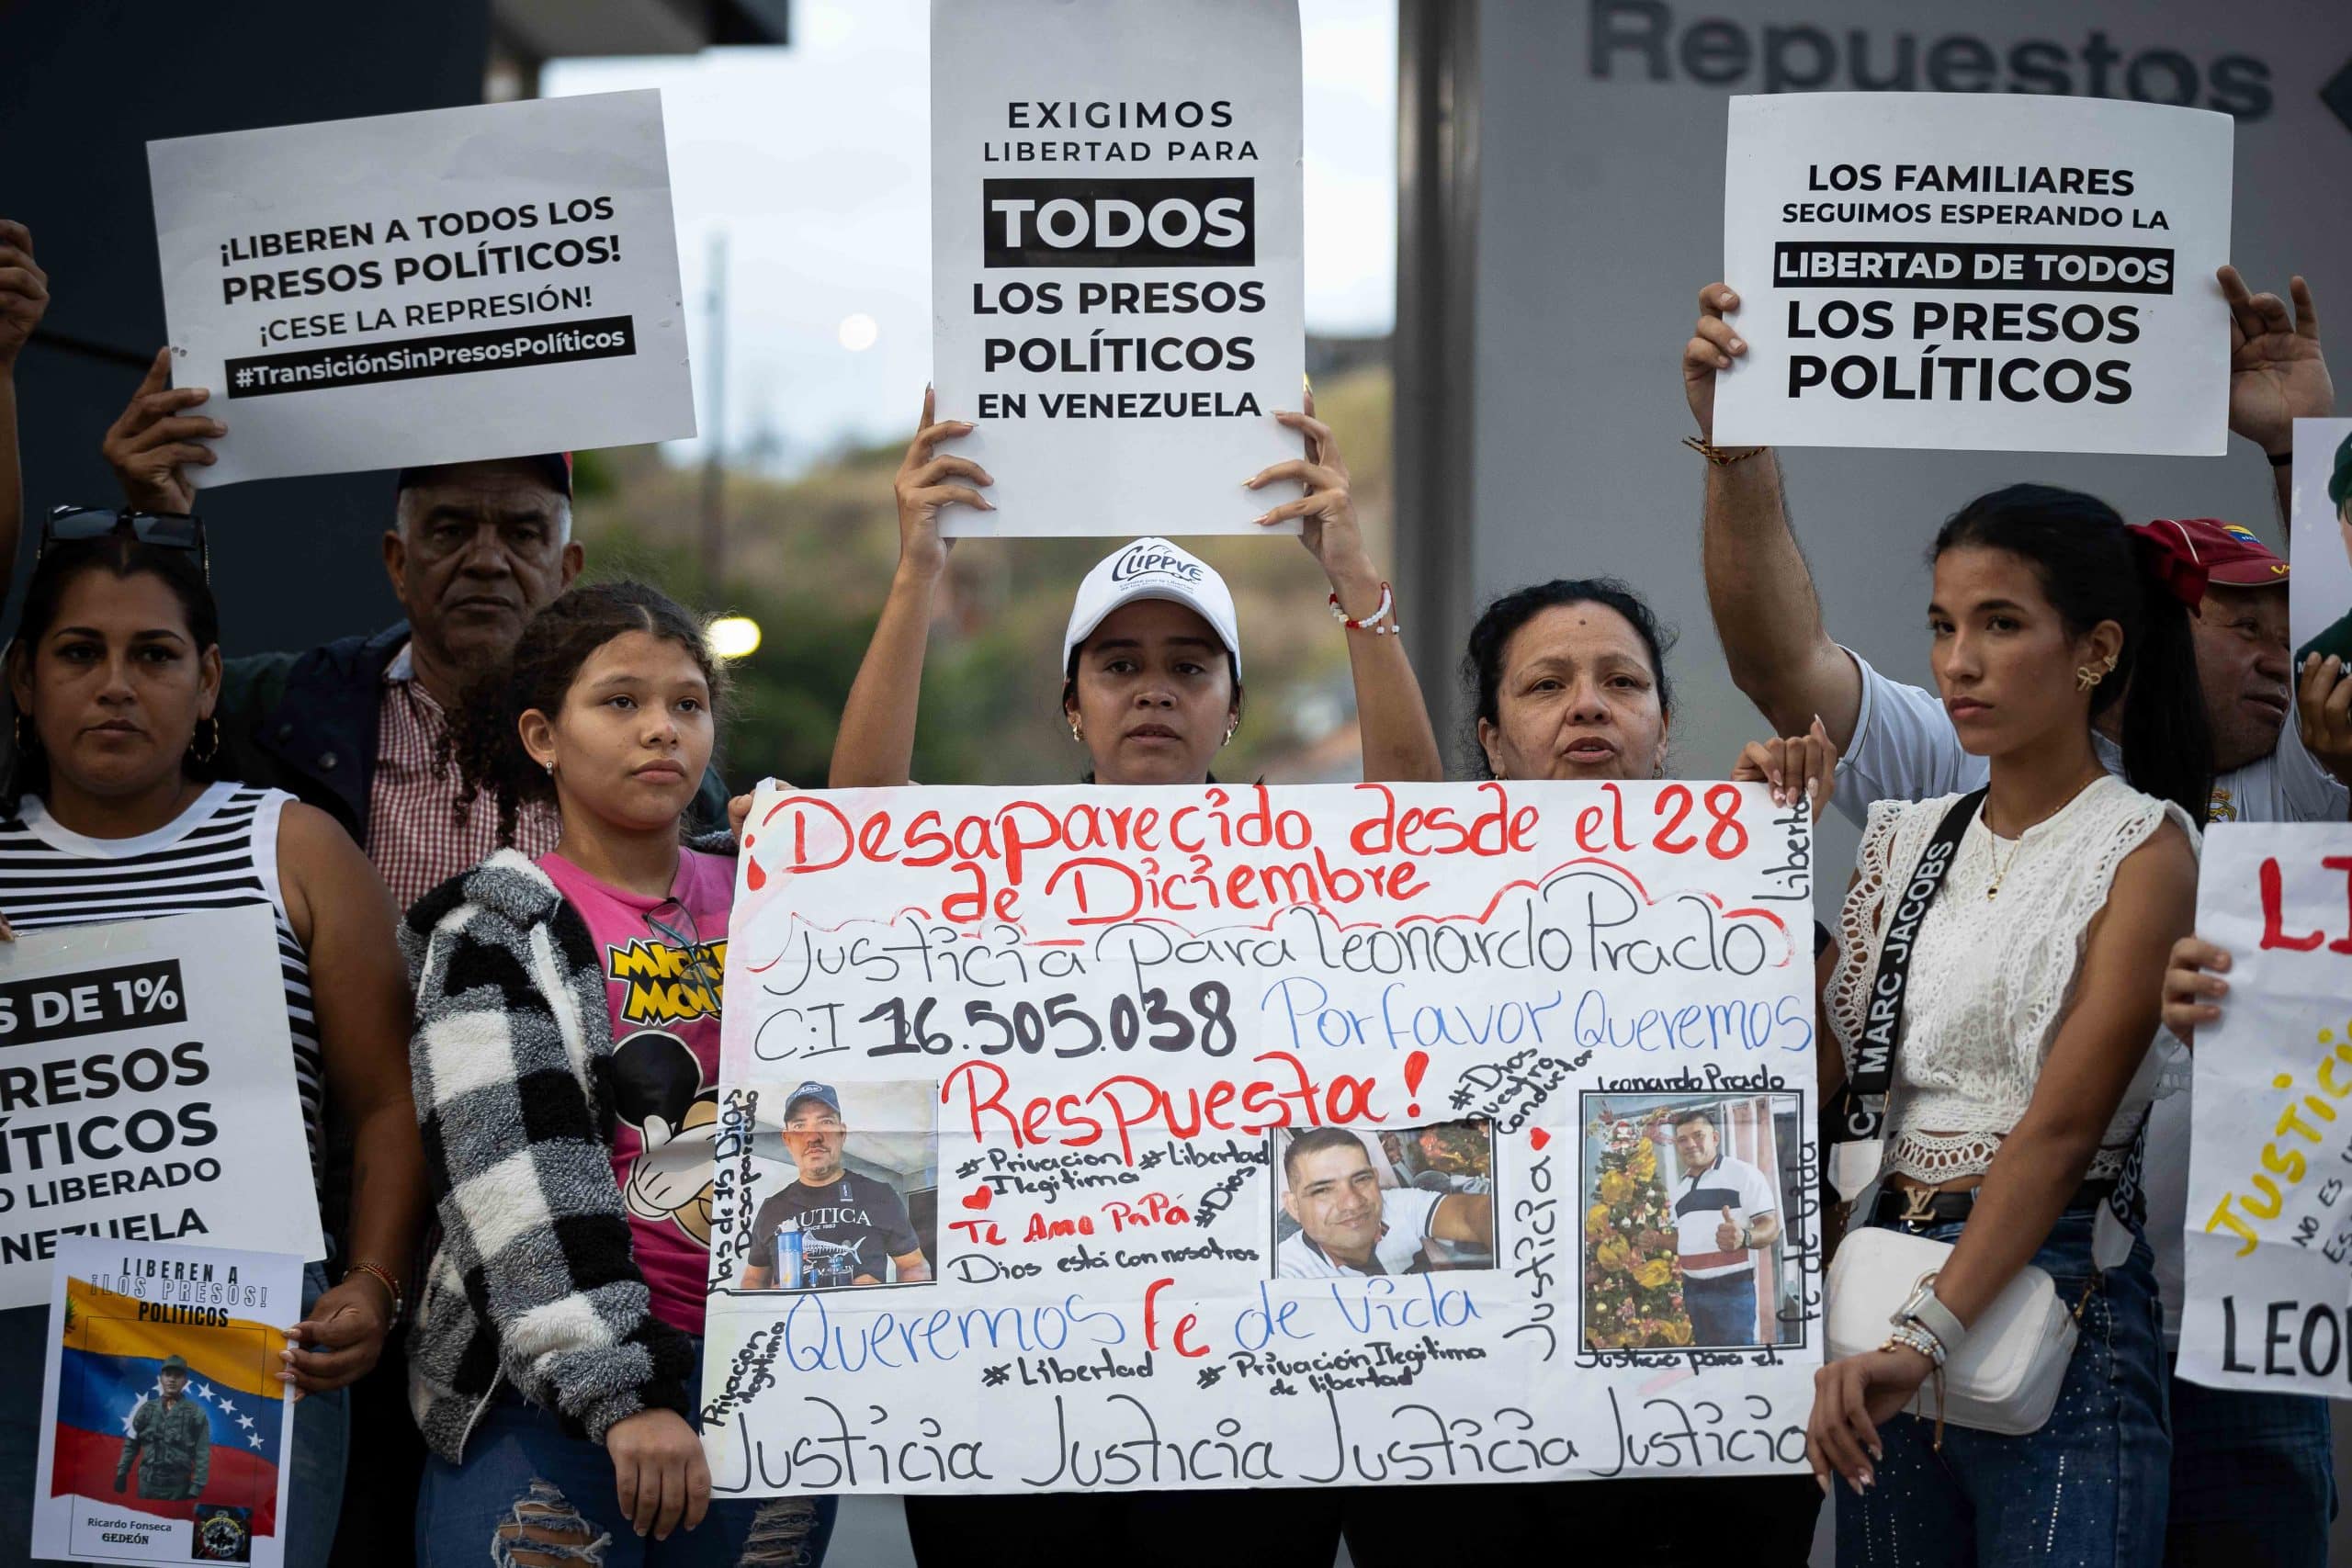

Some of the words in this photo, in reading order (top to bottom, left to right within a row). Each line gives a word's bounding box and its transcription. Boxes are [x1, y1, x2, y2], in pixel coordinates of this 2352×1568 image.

[1589, 0, 2274, 119] Repuestos
[1009, 100, 1233, 129] EXIGIMOS
[984, 141, 1151, 162] LIBERTAD
[1168, 141, 1259, 161] PARA
[1808, 164, 1882, 192] LOS
[1894, 164, 2134, 197] FAMILIARES
[220, 221, 374, 267] ¡LIBEREN
[385, 220, 410, 243] A
[417, 204, 538, 240] TODOS
[548, 197, 615, 225] LOS
[991, 197, 1246, 248] TODOS
[1781, 202, 1931, 224] SEGUIMOS
[1940, 204, 2122, 228] ESPERANDO
[2132, 209, 2170, 231] LA
[221, 260, 383, 305] PRESOS
[395, 234, 622, 286] POLÍTICOS!
[1779, 251, 1962, 281] LIBERTAD
[1973, 254, 2024, 281] DE
[2035, 254, 2169, 286] TODOS
[259, 313, 345, 348] ¡CESE
[356, 309, 397, 332] LA
[404, 286, 593, 325] REPRESIÓN!
[973, 282, 1063, 315] LOS
[1079, 280, 1266, 314] PRESOS
[1787, 299, 1894, 339] LOS
[1913, 300, 2140, 344] PRESOS
[235, 328, 626, 389] #TransiciónSinPresosPolíticos
[984, 328, 1256, 373] POLÍTICOS
[1788, 344, 2132, 405] POLÍTICOS
[978, 393, 1026, 419] EN
[1038, 391, 1261, 419] VENEZUELA
[1350, 783, 1540, 856] desde
[1576, 783, 1643, 852] el
[1653, 784, 1749, 860] 28
[941, 862, 1024, 922] de
[1046, 847, 1430, 925] Diciembre
[763, 916, 1086, 995] Justicia
[1544, 872, 1766, 975] Prado
[1859, 973, 1903, 1073] MARC
[1884, 840, 1954, 964] JACOBS
[31, 985, 104, 1028] DE
[113, 974, 179, 1017] 1%
[858, 981, 1237, 1058] 16.505.038
[1261, 976, 1374, 1049] Por
[1574, 989, 1813, 1052] Queremos
[1703, 1063, 1785, 1091] Prado
[27, 1157, 221, 1209] LIBERADO
[711, 1208, 733, 1234] de
[948, 1219, 1007, 1246] Te
[2291, 1215, 2320, 1247] NO
[2318, 1177, 2344, 1208] ES
[122, 1258, 214, 1282] LIBEREN
[228, 1266, 238, 1284] A
[947, 1253, 1042, 1283] Dios
[1161, 1236, 1260, 1264] nosotros
[1502, 1156, 1557, 1361] Justicia
[139, 1301, 229, 1327] POLITICOS
[162, 1279, 267, 1308] PRESOS!
[785, 1292, 1126, 1371] Queremos
[1235, 1280, 1317, 1351] de
[2222, 1295, 2352, 1384] LEO
[980, 1348, 1154, 1388] #Libertad
[1270, 1378, 1298, 1396] de
[711, 1395, 994, 1493] Justicia
[1022, 1393, 1283, 1489] Justicia
[1299, 1388, 1579, 1482] Justicia
[1588, 1386, 1807, 1477] Justicia
[87, 1517, 128, 1529] Ricardo
[130, 1520, 173, 1532] Fonseca
[102, 1532, 150, 1545] GEDEÓN
